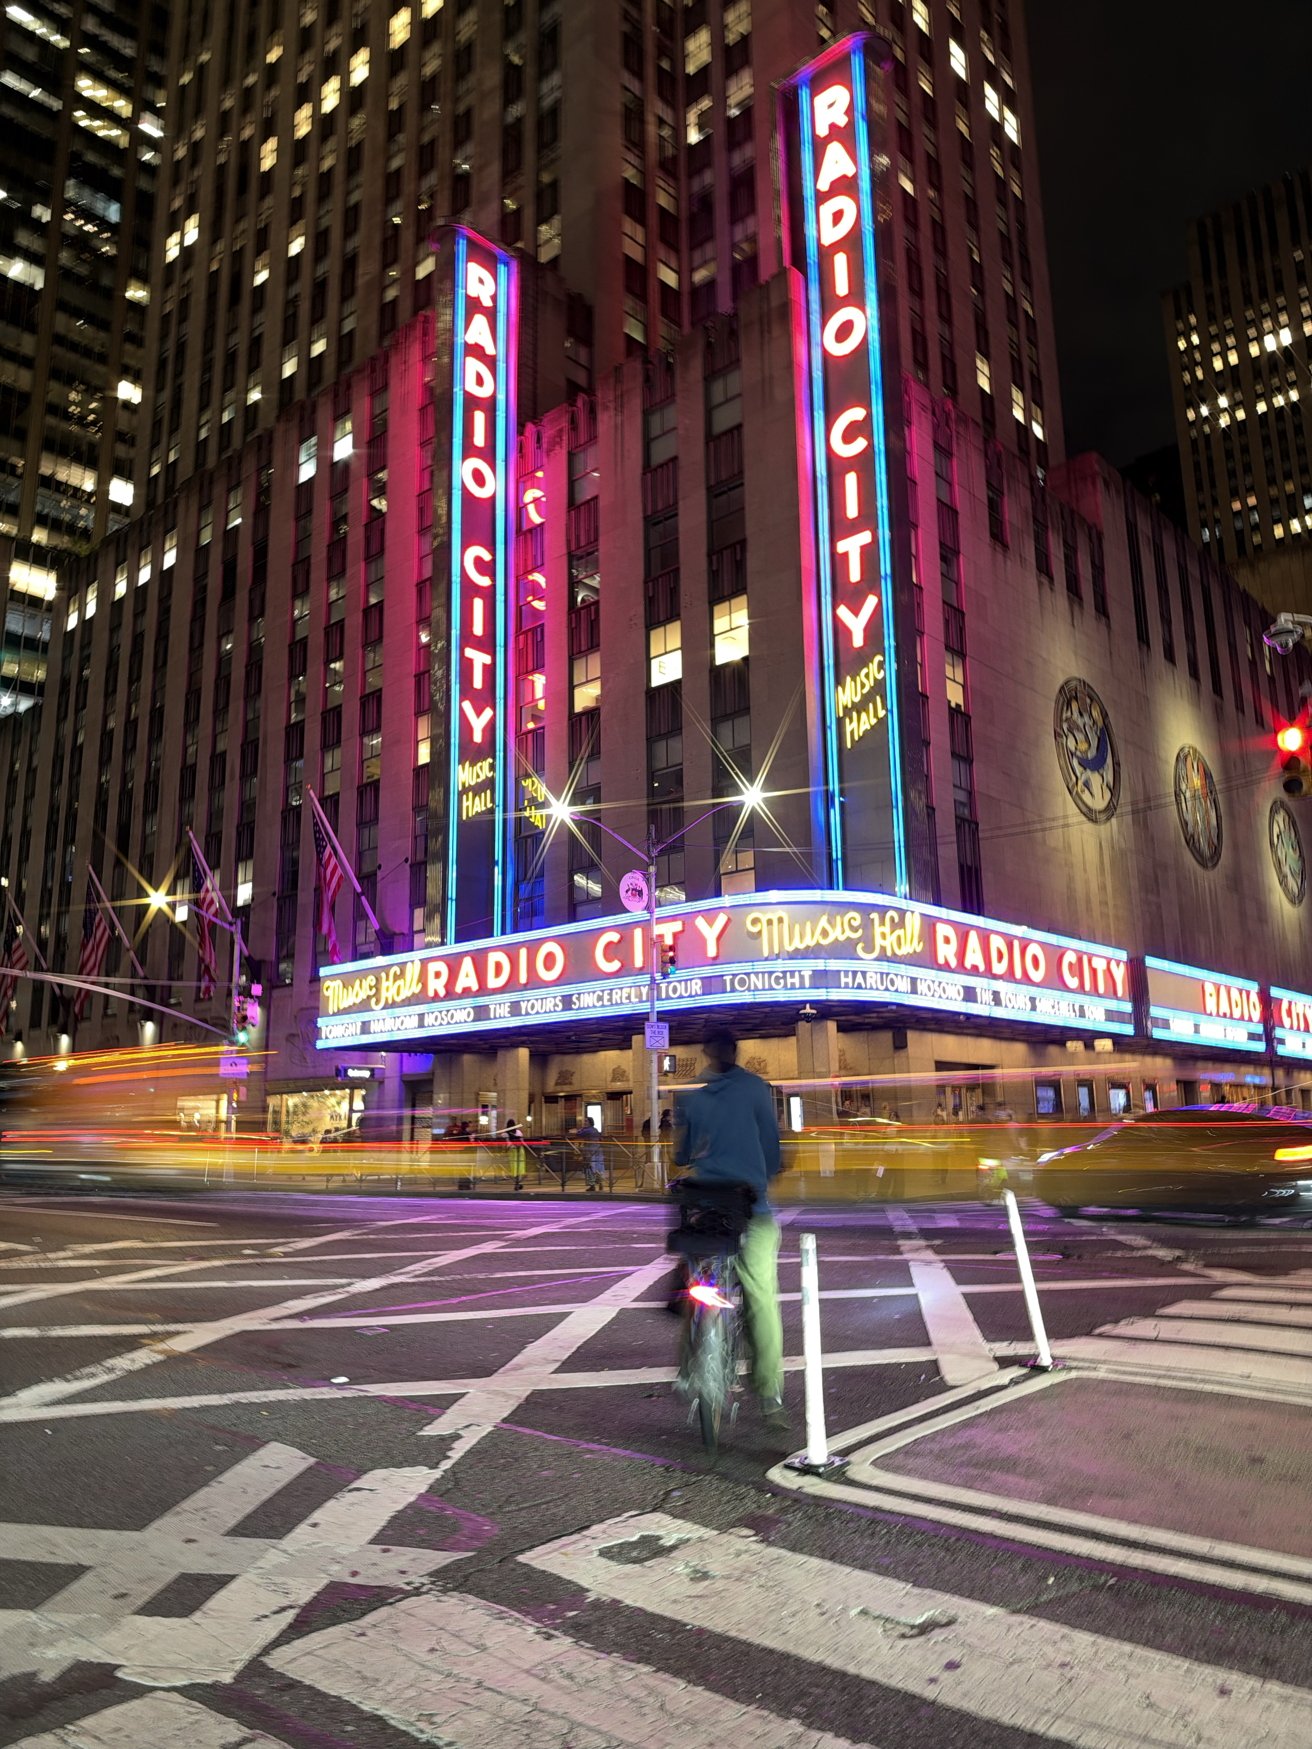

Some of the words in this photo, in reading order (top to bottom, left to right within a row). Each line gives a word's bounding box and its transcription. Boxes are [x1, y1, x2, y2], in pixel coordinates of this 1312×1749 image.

[814, 84, 866, 357] RADIO
[462, 261, 496, 499] RADIO
[829, 406, 878, 649] CITY
[461, 545, 494, 743] CITY
[845, 695, 886, 750] HALL
[462, 788, 493, 821] HALL
[426, 941, 565, 998] RADIO
[595, 912, 730, 974] CITY
[746, 911, 863, 957] Music
[856, 909, 924, 960] Hall
[935, 921, 1046, 983] RADIO
[1061, 949, 1128, 998] CITY
[323, 975, 376, 1015] Music
[370, 959, 422, 1011] Hall
[424, 1007, 475, 1027] HOSONO
[488, 1002, 511, 1019] THE
[520, 995, 563, 1016] YOURS
[571, 985, 649, 1010] SINCERELY
[660, 979, 702, 999] TOUR
[723, 970, 814, 991] TONIGHT
[840, 970, 911, 994] HARUOMI
[917, 979, 964, 1001] HOSONO
[976, 987, 995, 1006] THE
[1204, 981, 1262, 1023] RADIO
